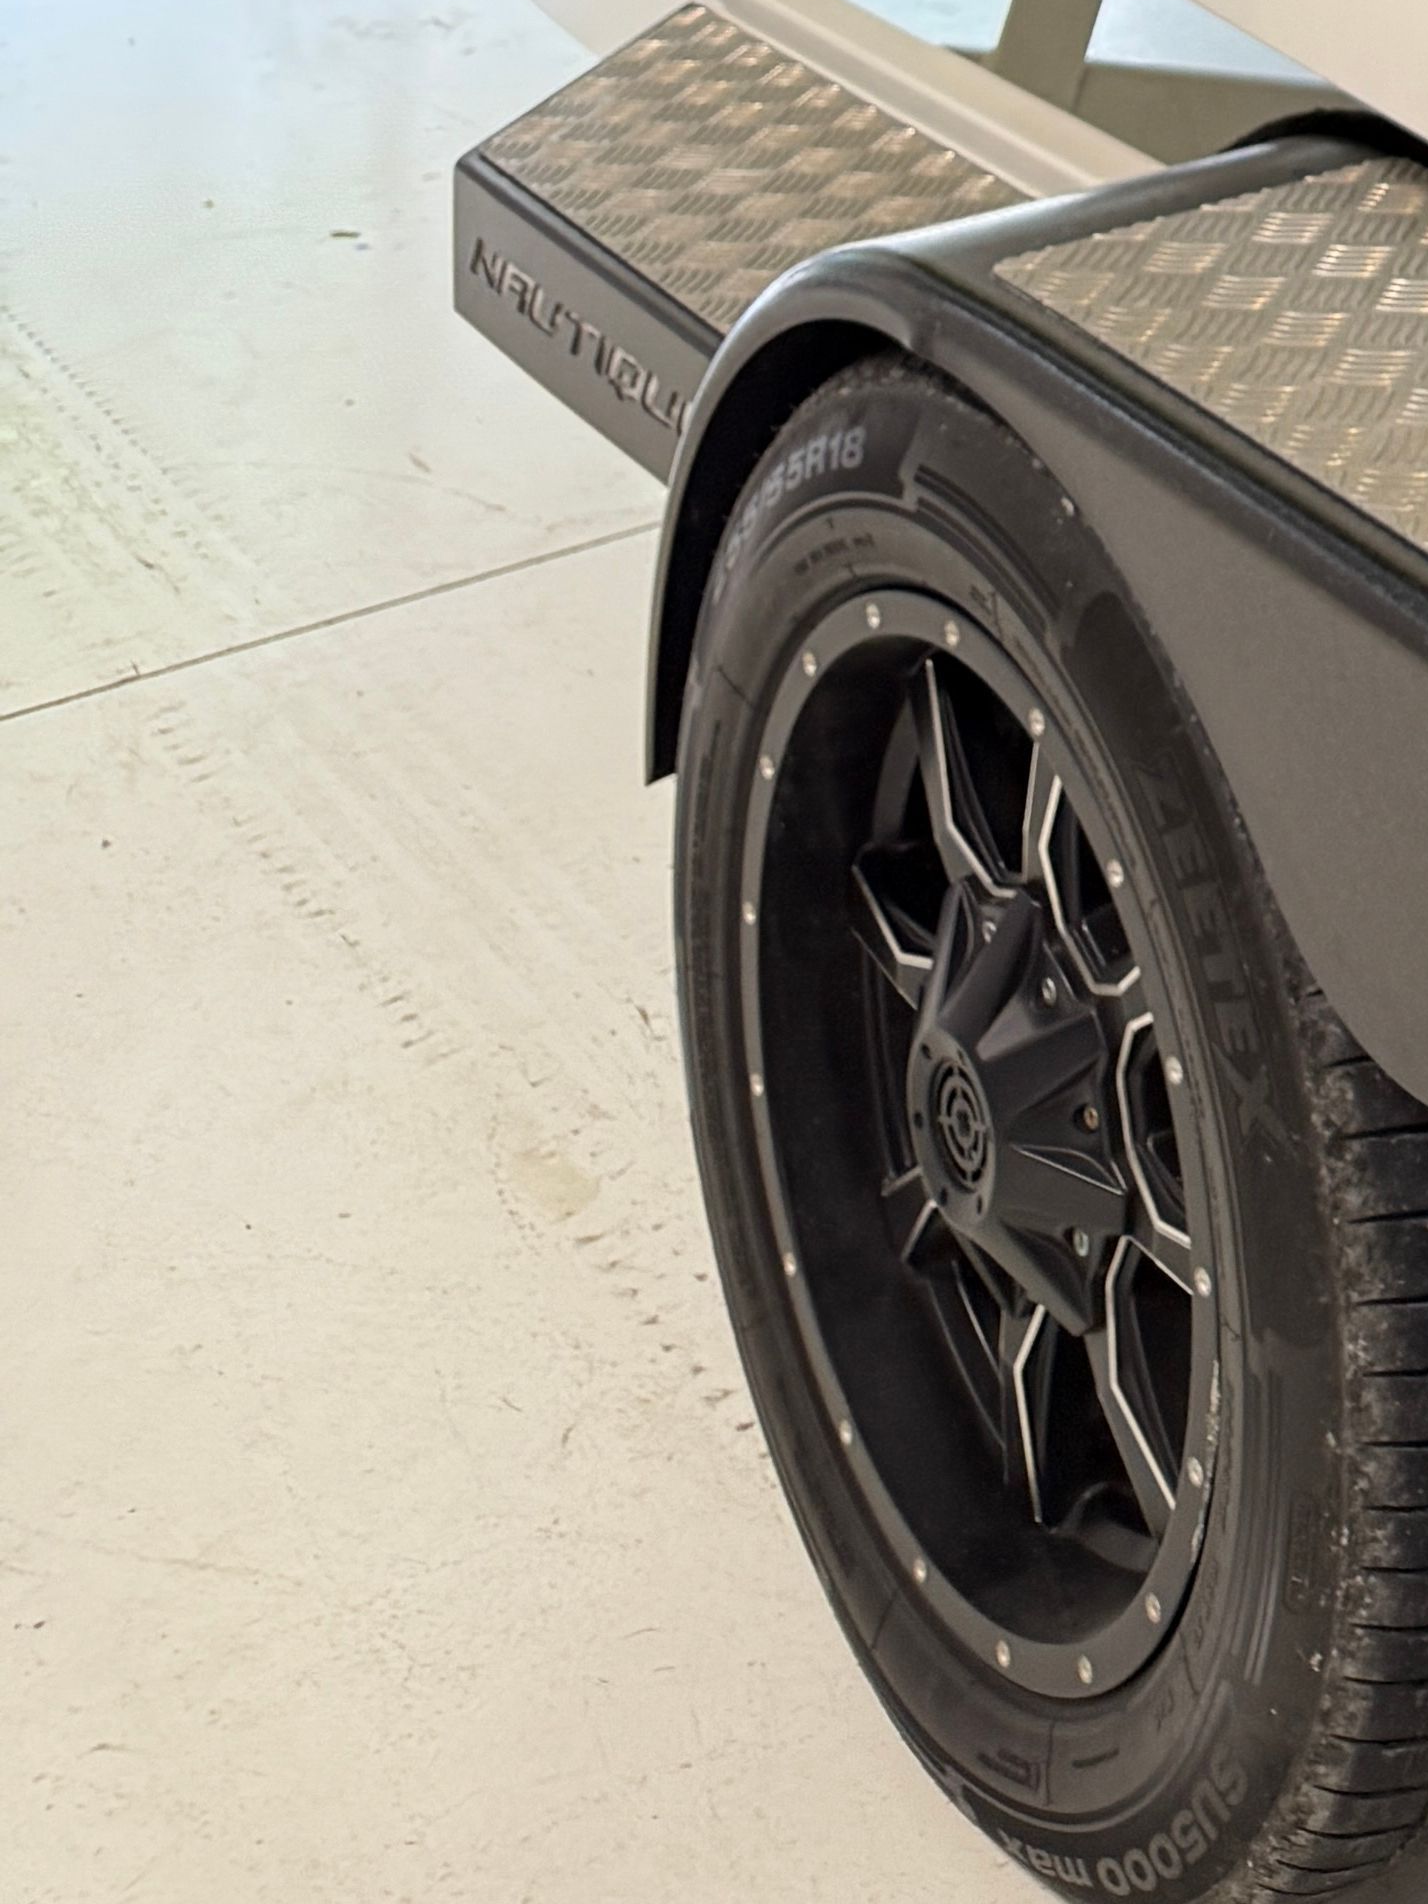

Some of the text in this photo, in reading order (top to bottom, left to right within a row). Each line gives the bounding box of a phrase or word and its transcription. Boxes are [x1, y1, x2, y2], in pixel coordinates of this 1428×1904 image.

[470, 238, 689, 438] NAUTIQU
[1000, 1829, 1095, 1889] max
[1096, 1747, 1249, 1896] SU5000
